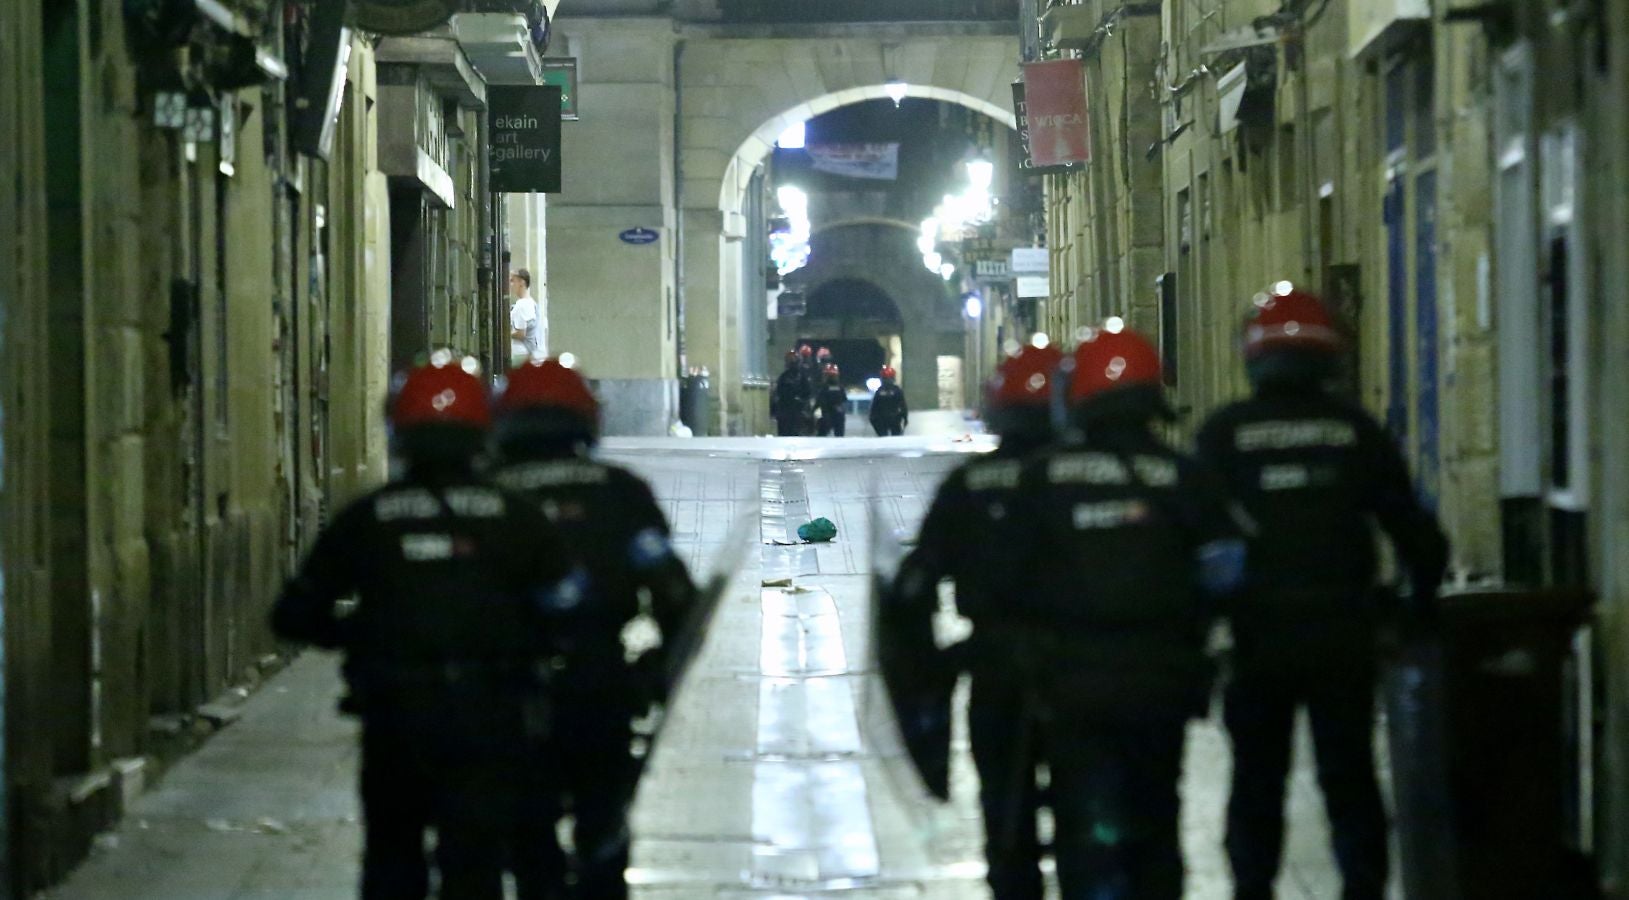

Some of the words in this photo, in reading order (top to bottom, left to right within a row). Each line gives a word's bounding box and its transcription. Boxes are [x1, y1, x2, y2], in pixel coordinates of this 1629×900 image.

[495, 114, 538, 129] ekain
[496, 130, 519, 144] art
[495, 144, 551, 162] gallery
